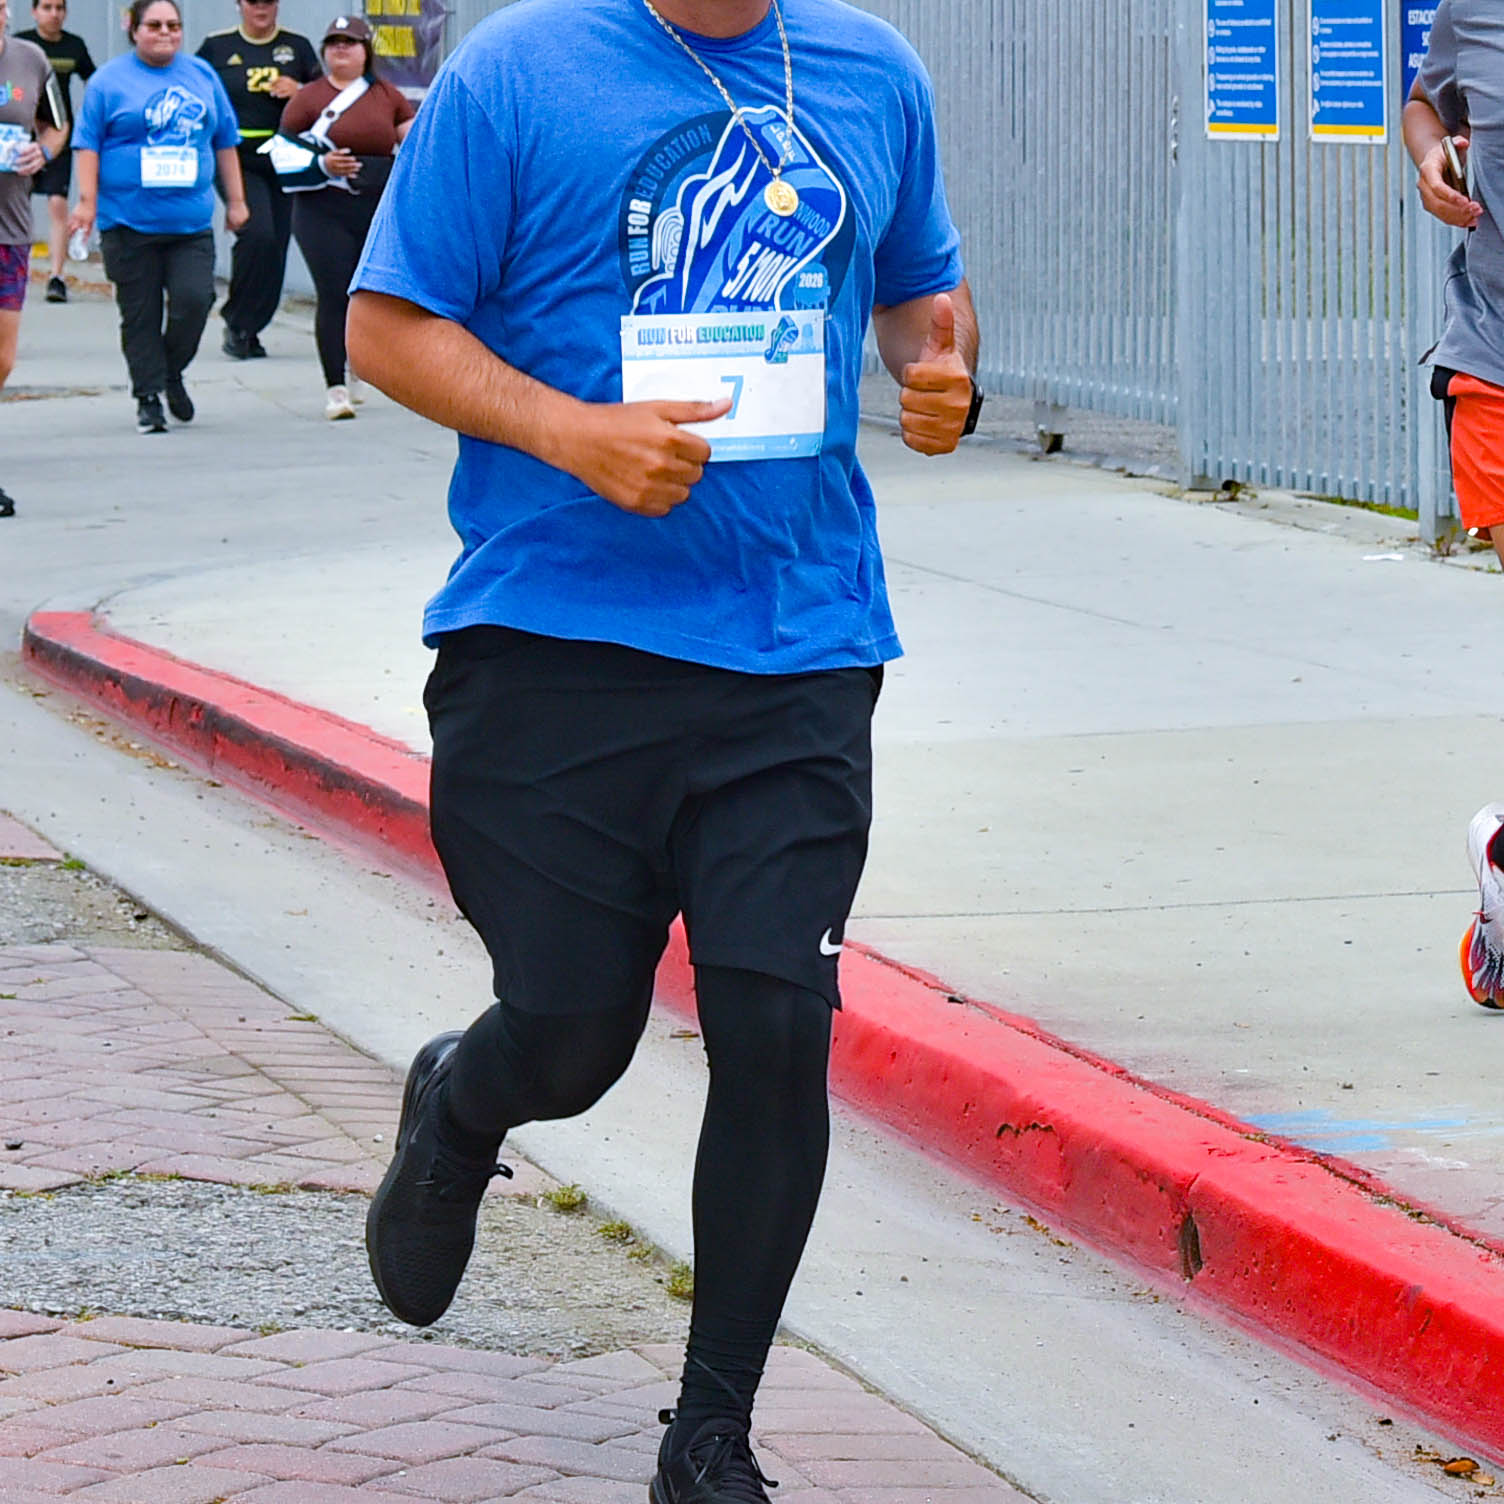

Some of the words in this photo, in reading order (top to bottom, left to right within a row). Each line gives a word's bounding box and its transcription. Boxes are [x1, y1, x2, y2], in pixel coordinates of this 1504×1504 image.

[635, 123, 713, 198] EDUCATION
[627, 198, 652, 236] FOR
[757, 214, 815, 257] RUN
[629, 236, 651, 277] RUN
[721, 240, 799, 303] 5/10K
[638, 326, 667, 346] RUN
[668, 325, 693, 345] FOR
[695, 323, 765, 344] EDUCATION
[720, 374, 745, 421] 7
